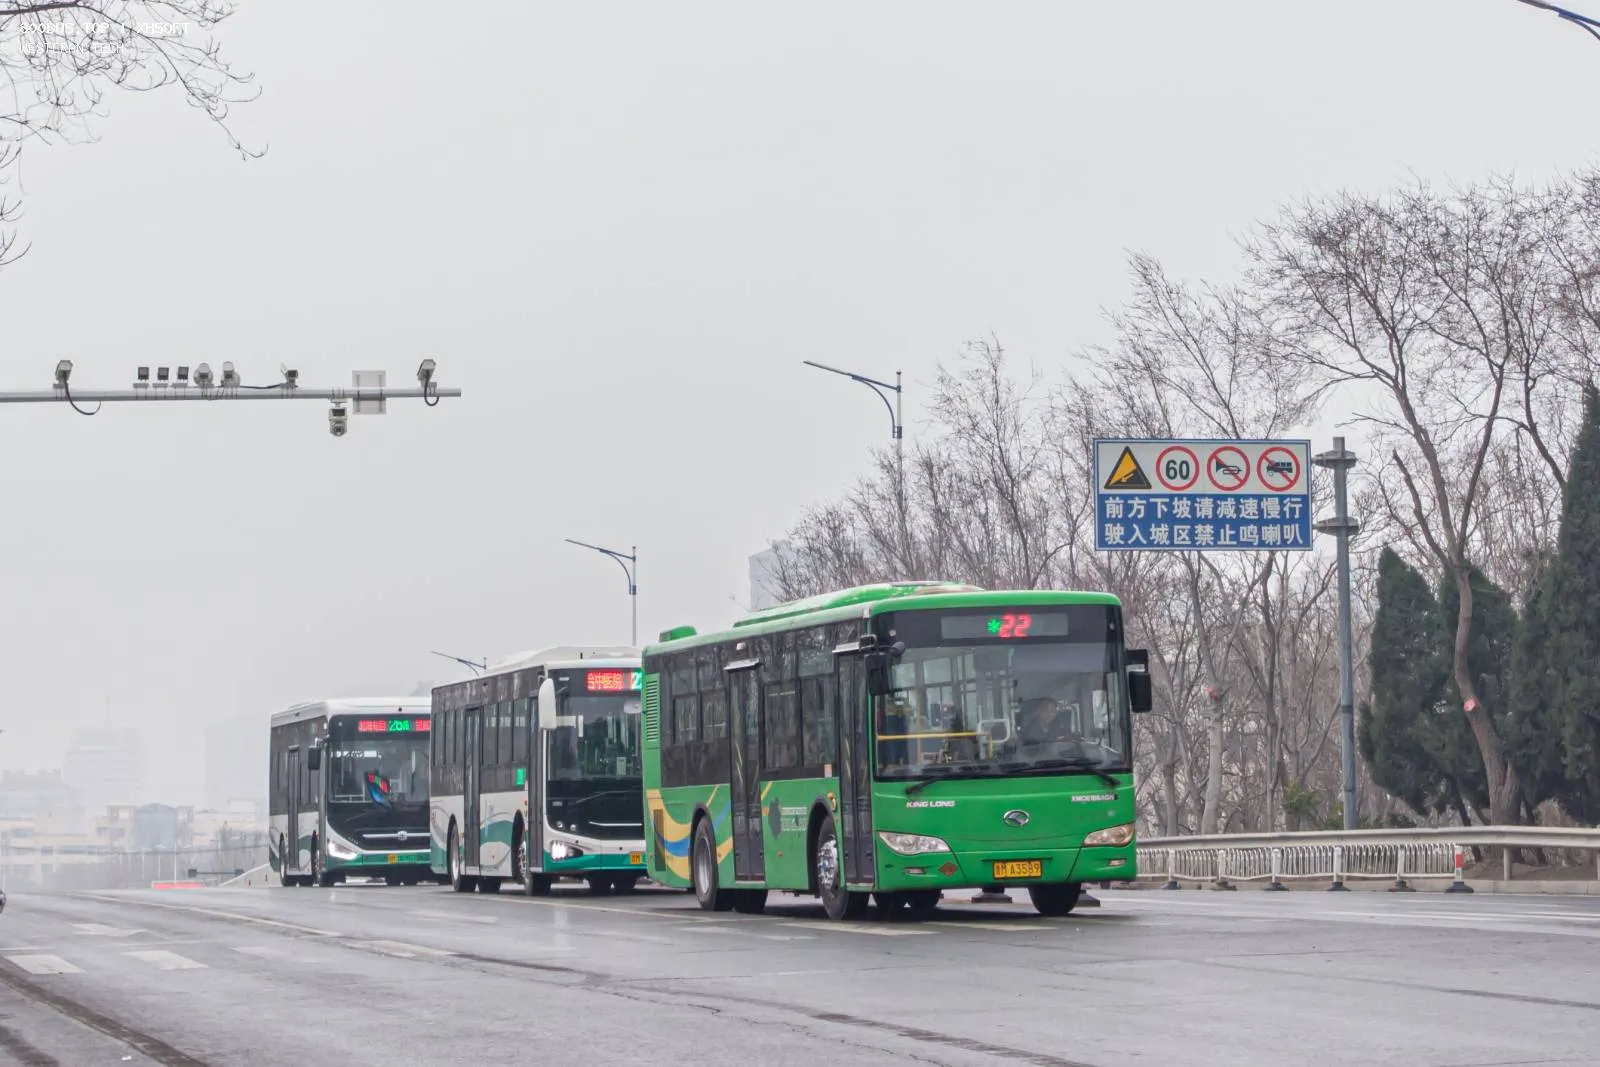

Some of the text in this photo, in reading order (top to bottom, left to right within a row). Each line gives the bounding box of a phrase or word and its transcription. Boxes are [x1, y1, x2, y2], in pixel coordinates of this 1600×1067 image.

[1165, 459, 1190, 480] 60
[1104, 496, 1303, 519] 前方下坡请减速慢行
[1104, 523, 1303, 545] 驶入城区禁止鸣喇叭
[999, 613, 1032, 638] 22
[906, 800, 956, 809] KING LONG
